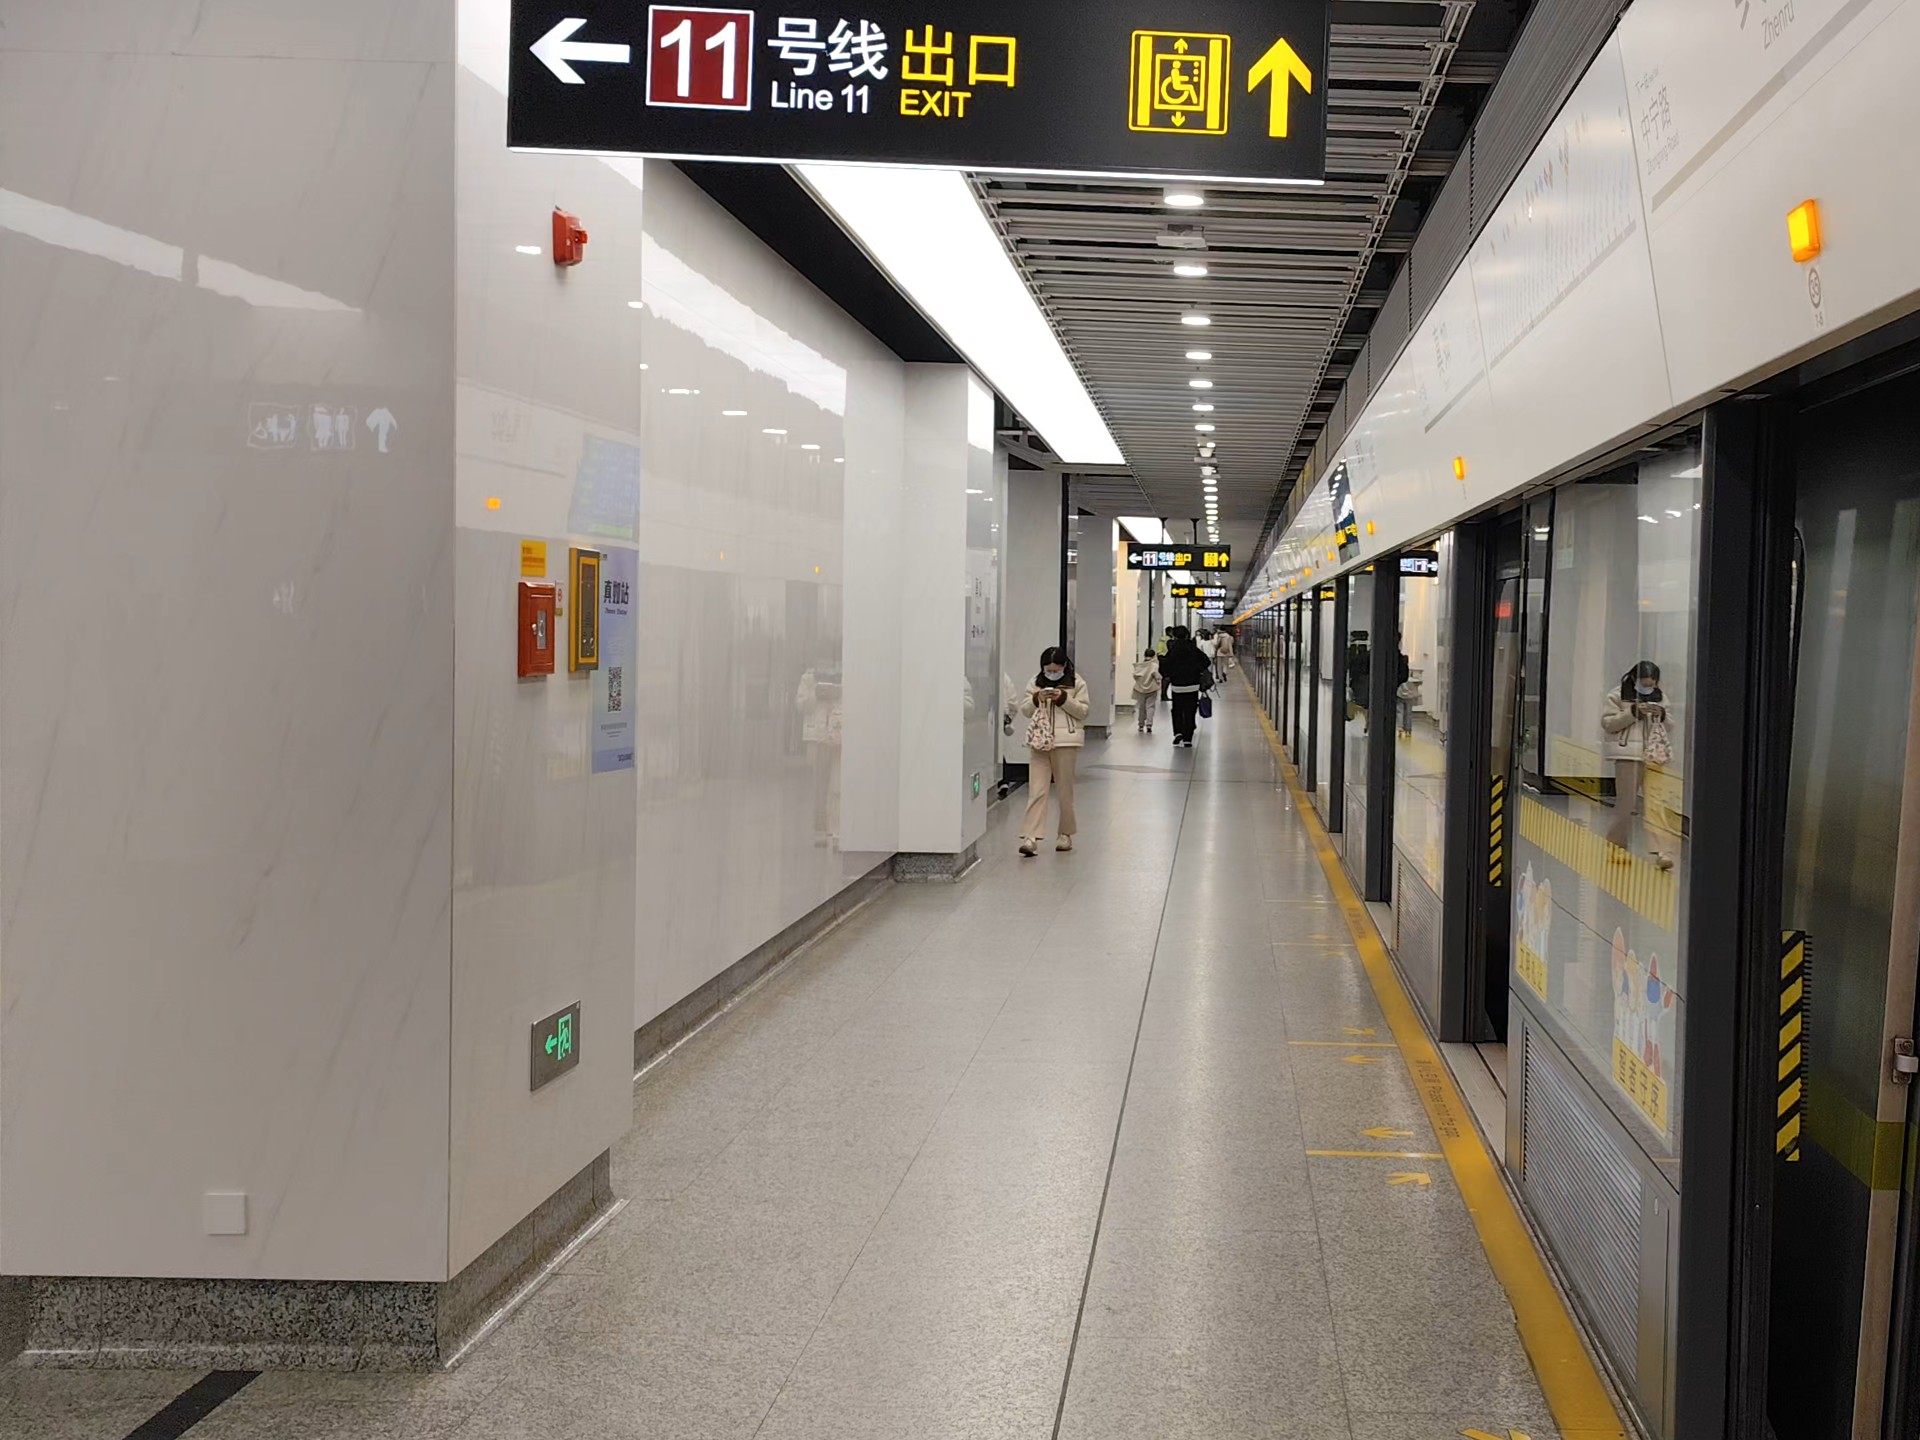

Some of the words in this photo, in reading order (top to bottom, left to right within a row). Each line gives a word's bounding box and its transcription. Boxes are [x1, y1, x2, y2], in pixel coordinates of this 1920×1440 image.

[1761, 0, 1794, 50] Zhenru
[660, 19, 736, 99] 11
[768, 17, 888, 79] 号线
[902, 25, 1016, 87] 出口
[771, 81, 833, 111] Line
[841, 84, 868, 114] 11
[900, 89, 971, 118] EXIT
